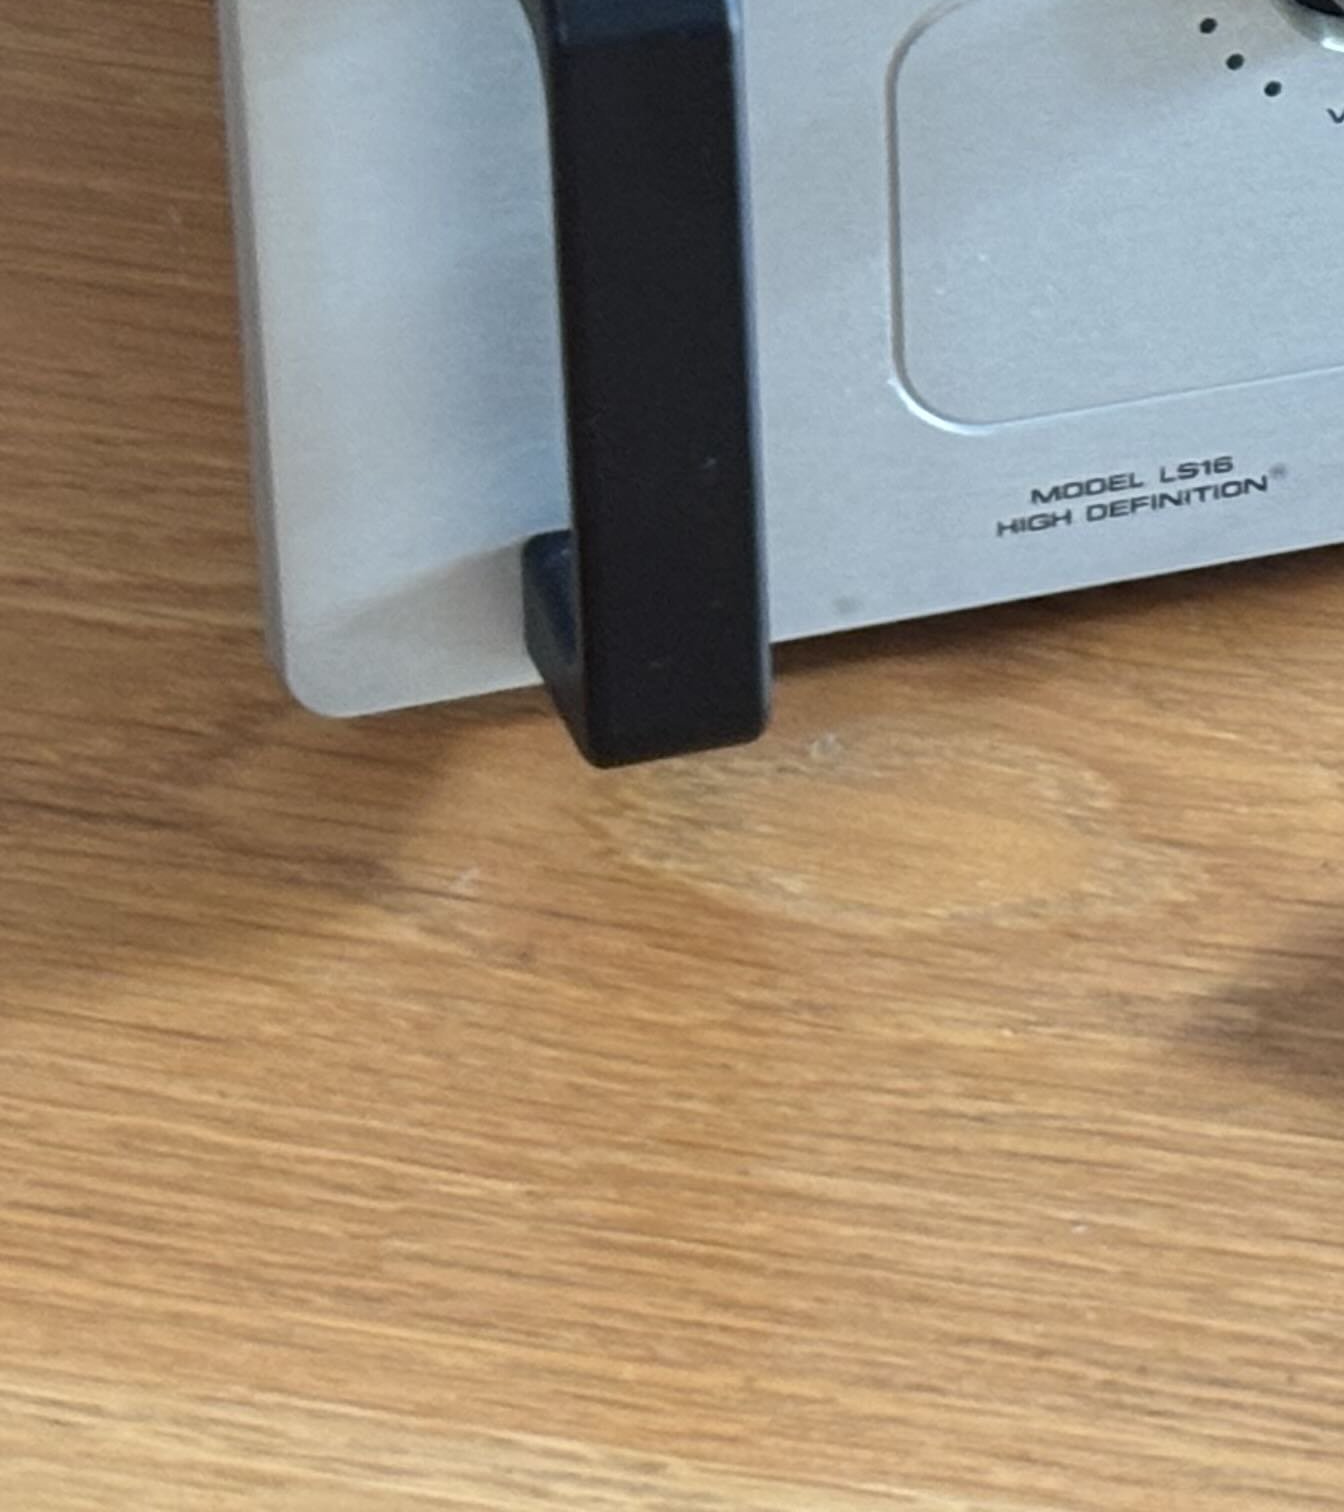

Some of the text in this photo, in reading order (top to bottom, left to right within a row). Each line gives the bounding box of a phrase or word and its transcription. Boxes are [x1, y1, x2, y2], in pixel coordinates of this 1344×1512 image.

[1031, 455, 1234, 505] MODEL LS16
[996, 509, 1072, 537] HIGH
